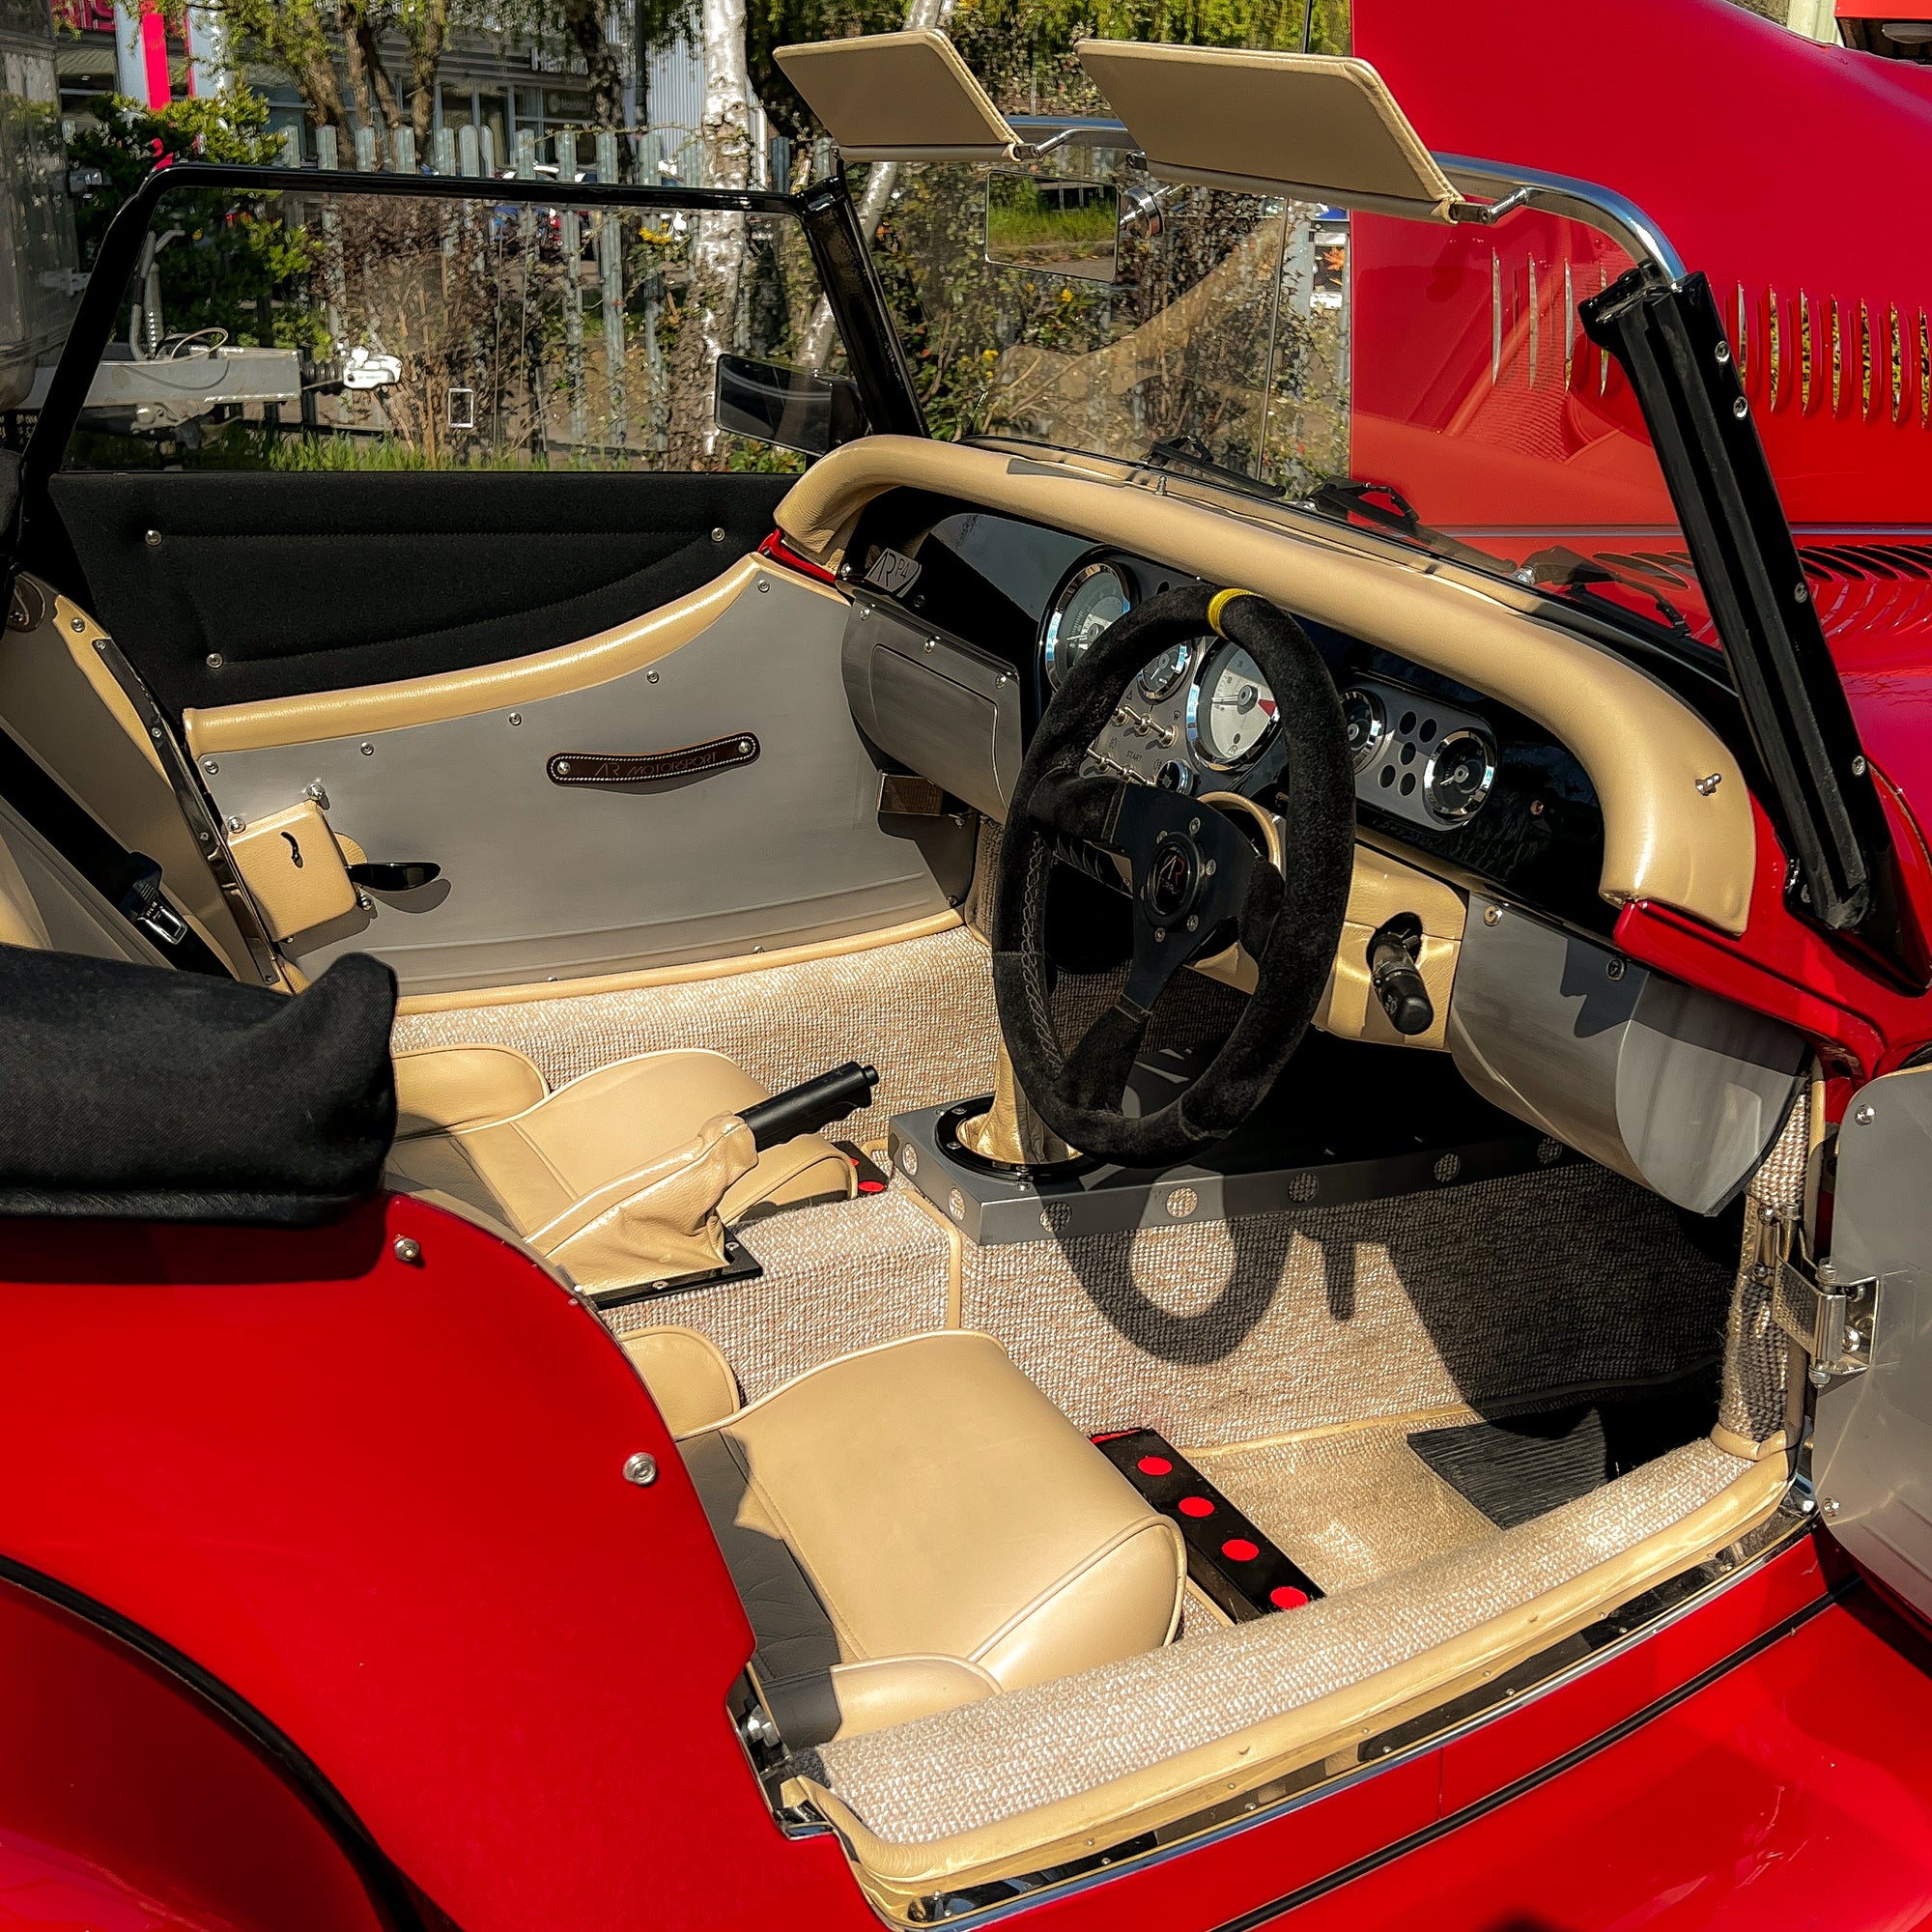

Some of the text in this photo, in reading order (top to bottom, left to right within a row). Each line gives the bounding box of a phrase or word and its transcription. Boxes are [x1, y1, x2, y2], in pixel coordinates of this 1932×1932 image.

[594, 751, 718, 777] AR MOTORSPORT
[1125, 750, 1143, 763] START
